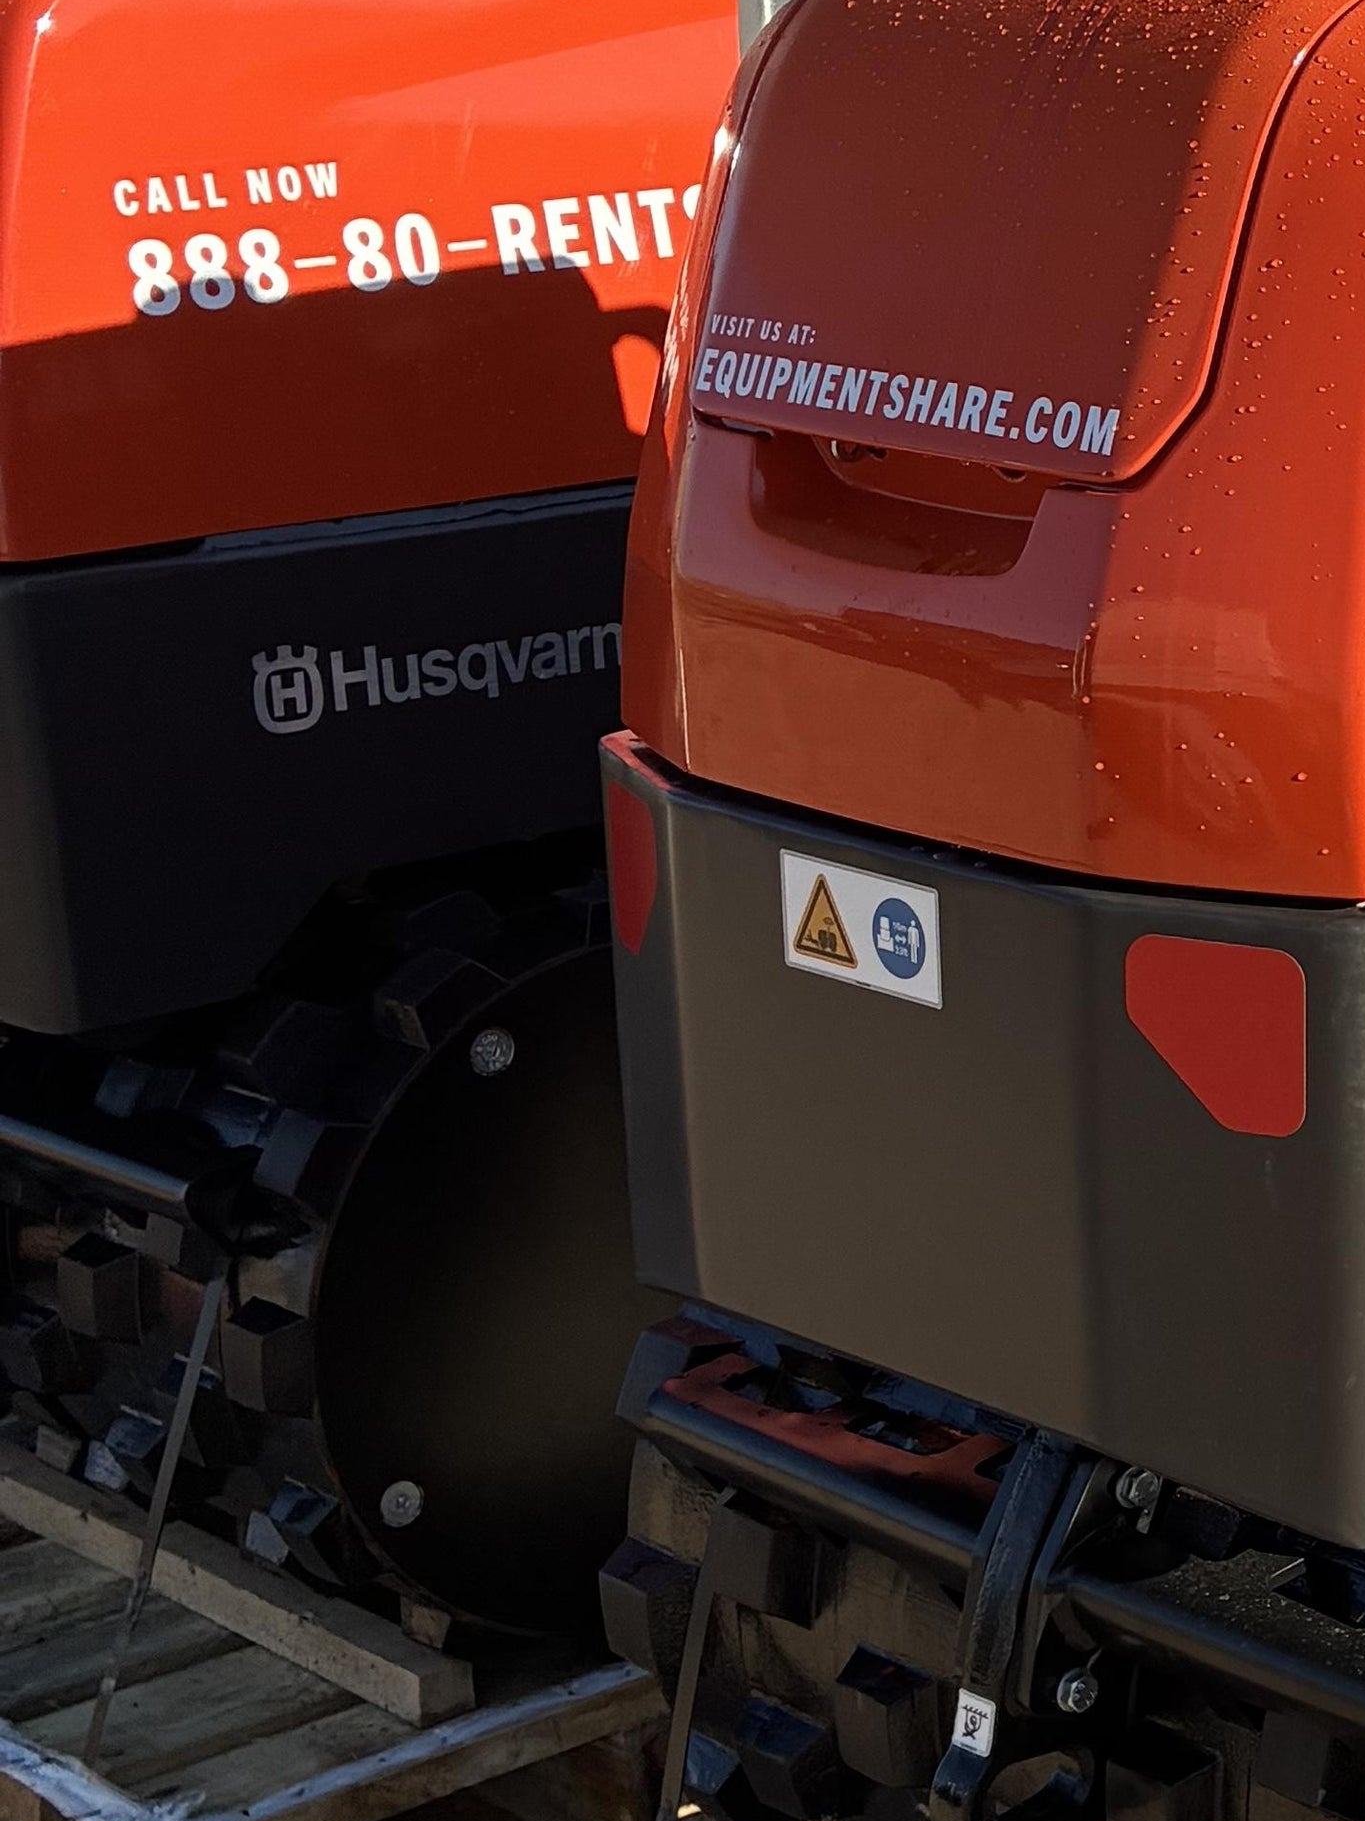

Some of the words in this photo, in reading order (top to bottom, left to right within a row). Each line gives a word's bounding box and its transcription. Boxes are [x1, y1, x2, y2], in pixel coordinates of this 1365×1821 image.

[113, 171, 228, 217] CALL
[244, 161, 339, 206] NOW
[127, 183, 703, 316] 888-80-RENT
[709, 313, 756, 340] VISIT
[759, 320, 783, 343] US
[788, 323, 816, 346] AT:
[695, 348, 1122, 457] EQUIPMENTSHARE.COM
[330, 622, 623, 712] Husqvarn
